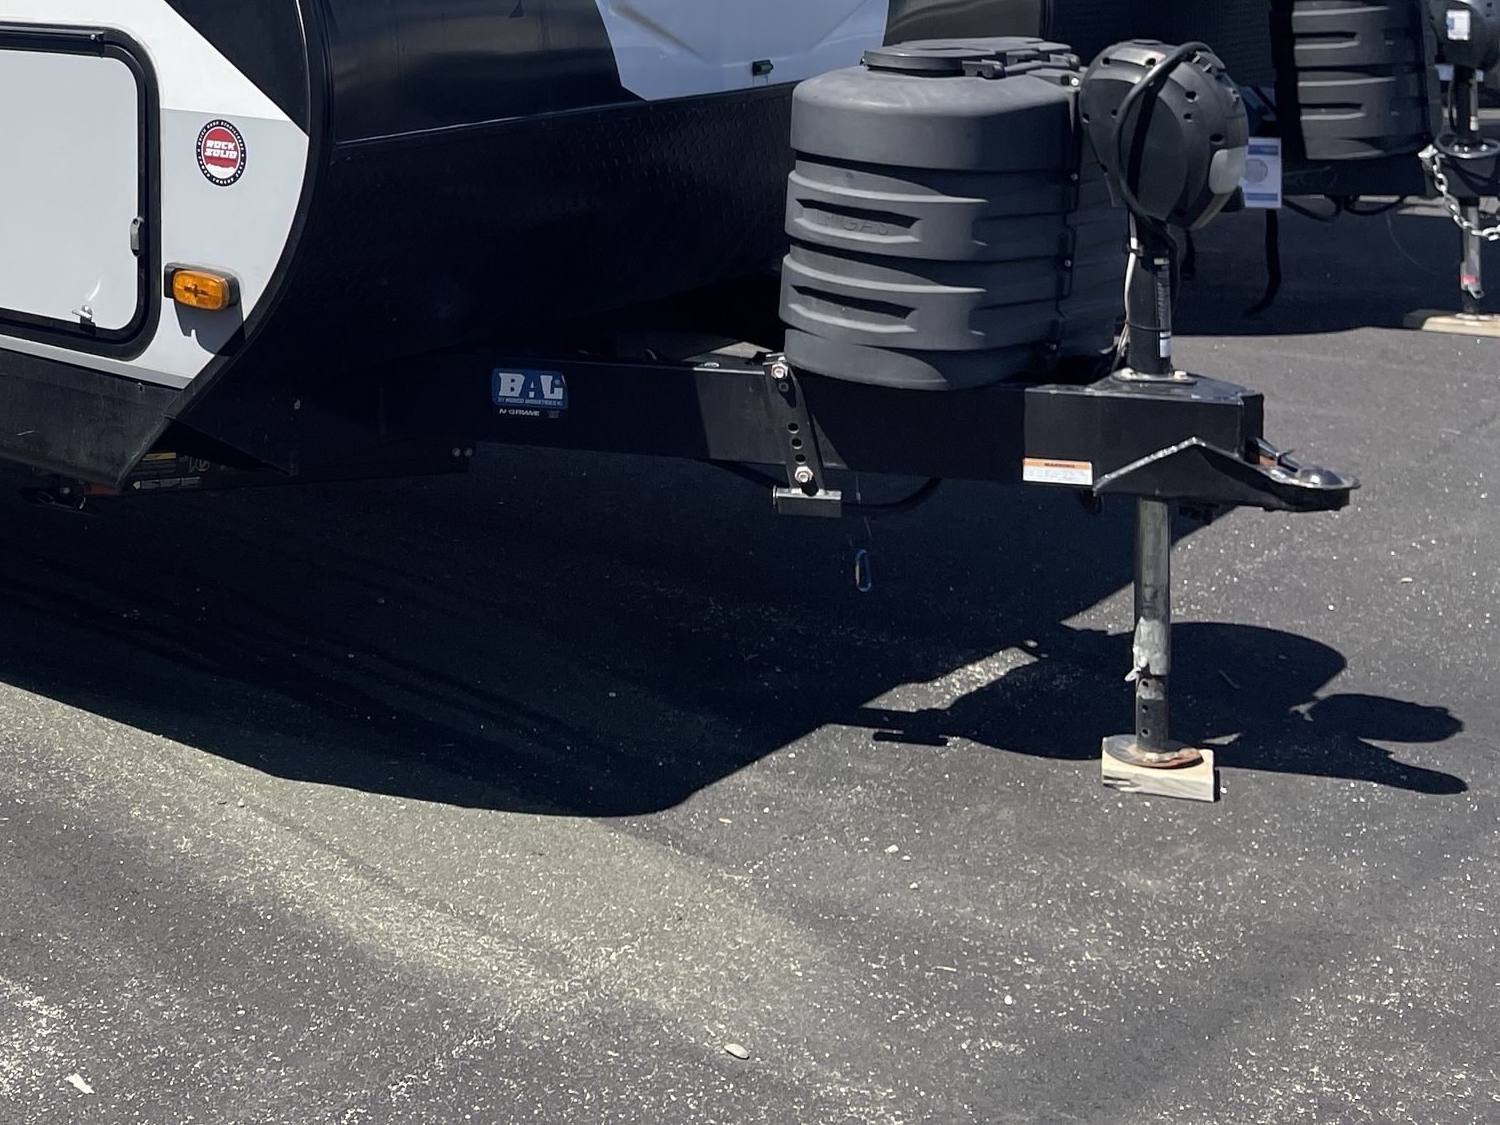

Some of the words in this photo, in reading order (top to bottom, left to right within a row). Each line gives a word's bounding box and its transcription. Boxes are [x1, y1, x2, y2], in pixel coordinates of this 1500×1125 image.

[206, 139, 236, 150] ROCK
[204, 148, 238, 160] SOLID
[498, 372, 564, 400] BAL
